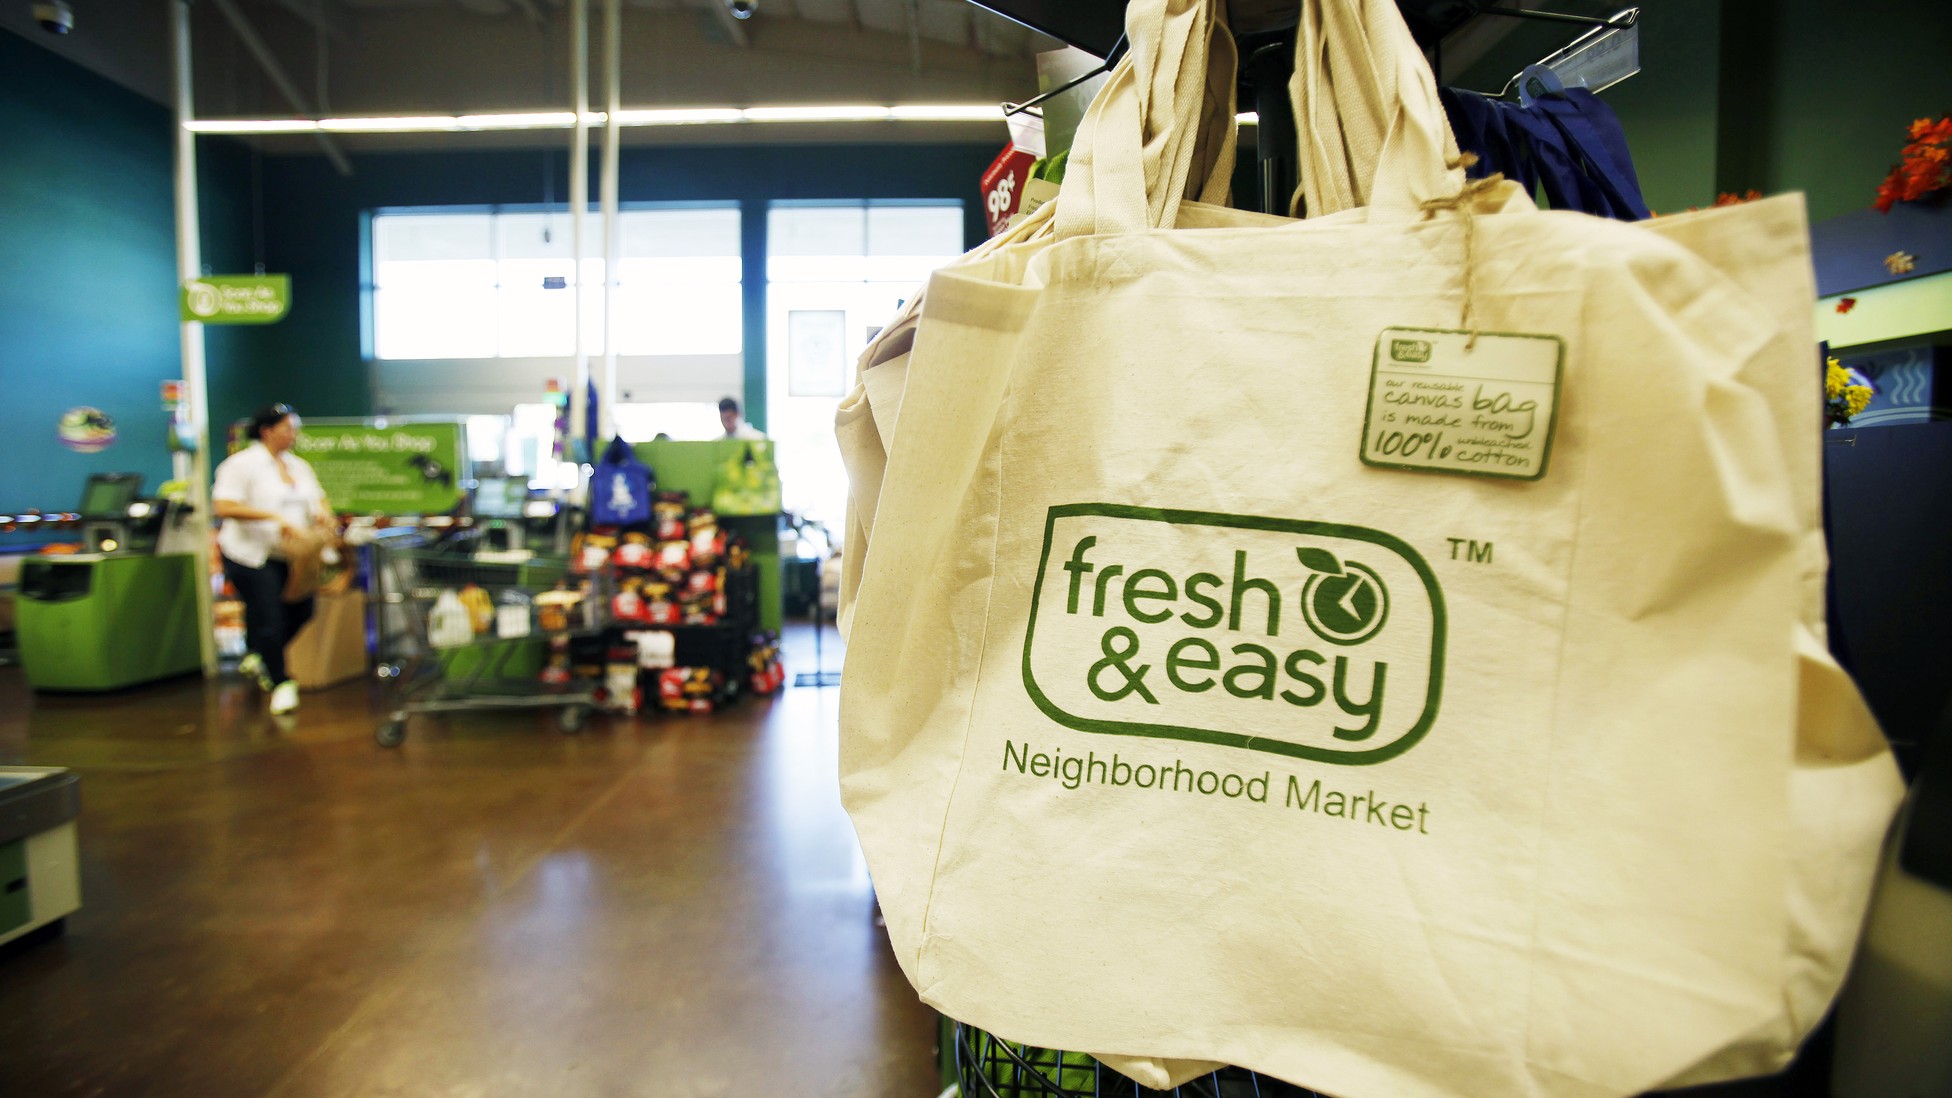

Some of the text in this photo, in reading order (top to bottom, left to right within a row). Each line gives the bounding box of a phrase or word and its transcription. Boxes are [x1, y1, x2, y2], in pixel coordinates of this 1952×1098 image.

[1385, 379, 1465, 392] our reusable
[1382, 410, 1515, 433] is made from
[1384, 384, 1539, 440] canvas bag
[1375, 430, 1535, 460] 100% unbleached
[1456, 450, 1531, 469] cotton
[1063, 535, 1495, 636] fresh TM
[1087, 625, 1388, 742] & easy
[1002, 739, 1431, 836] Neighborhood Market
